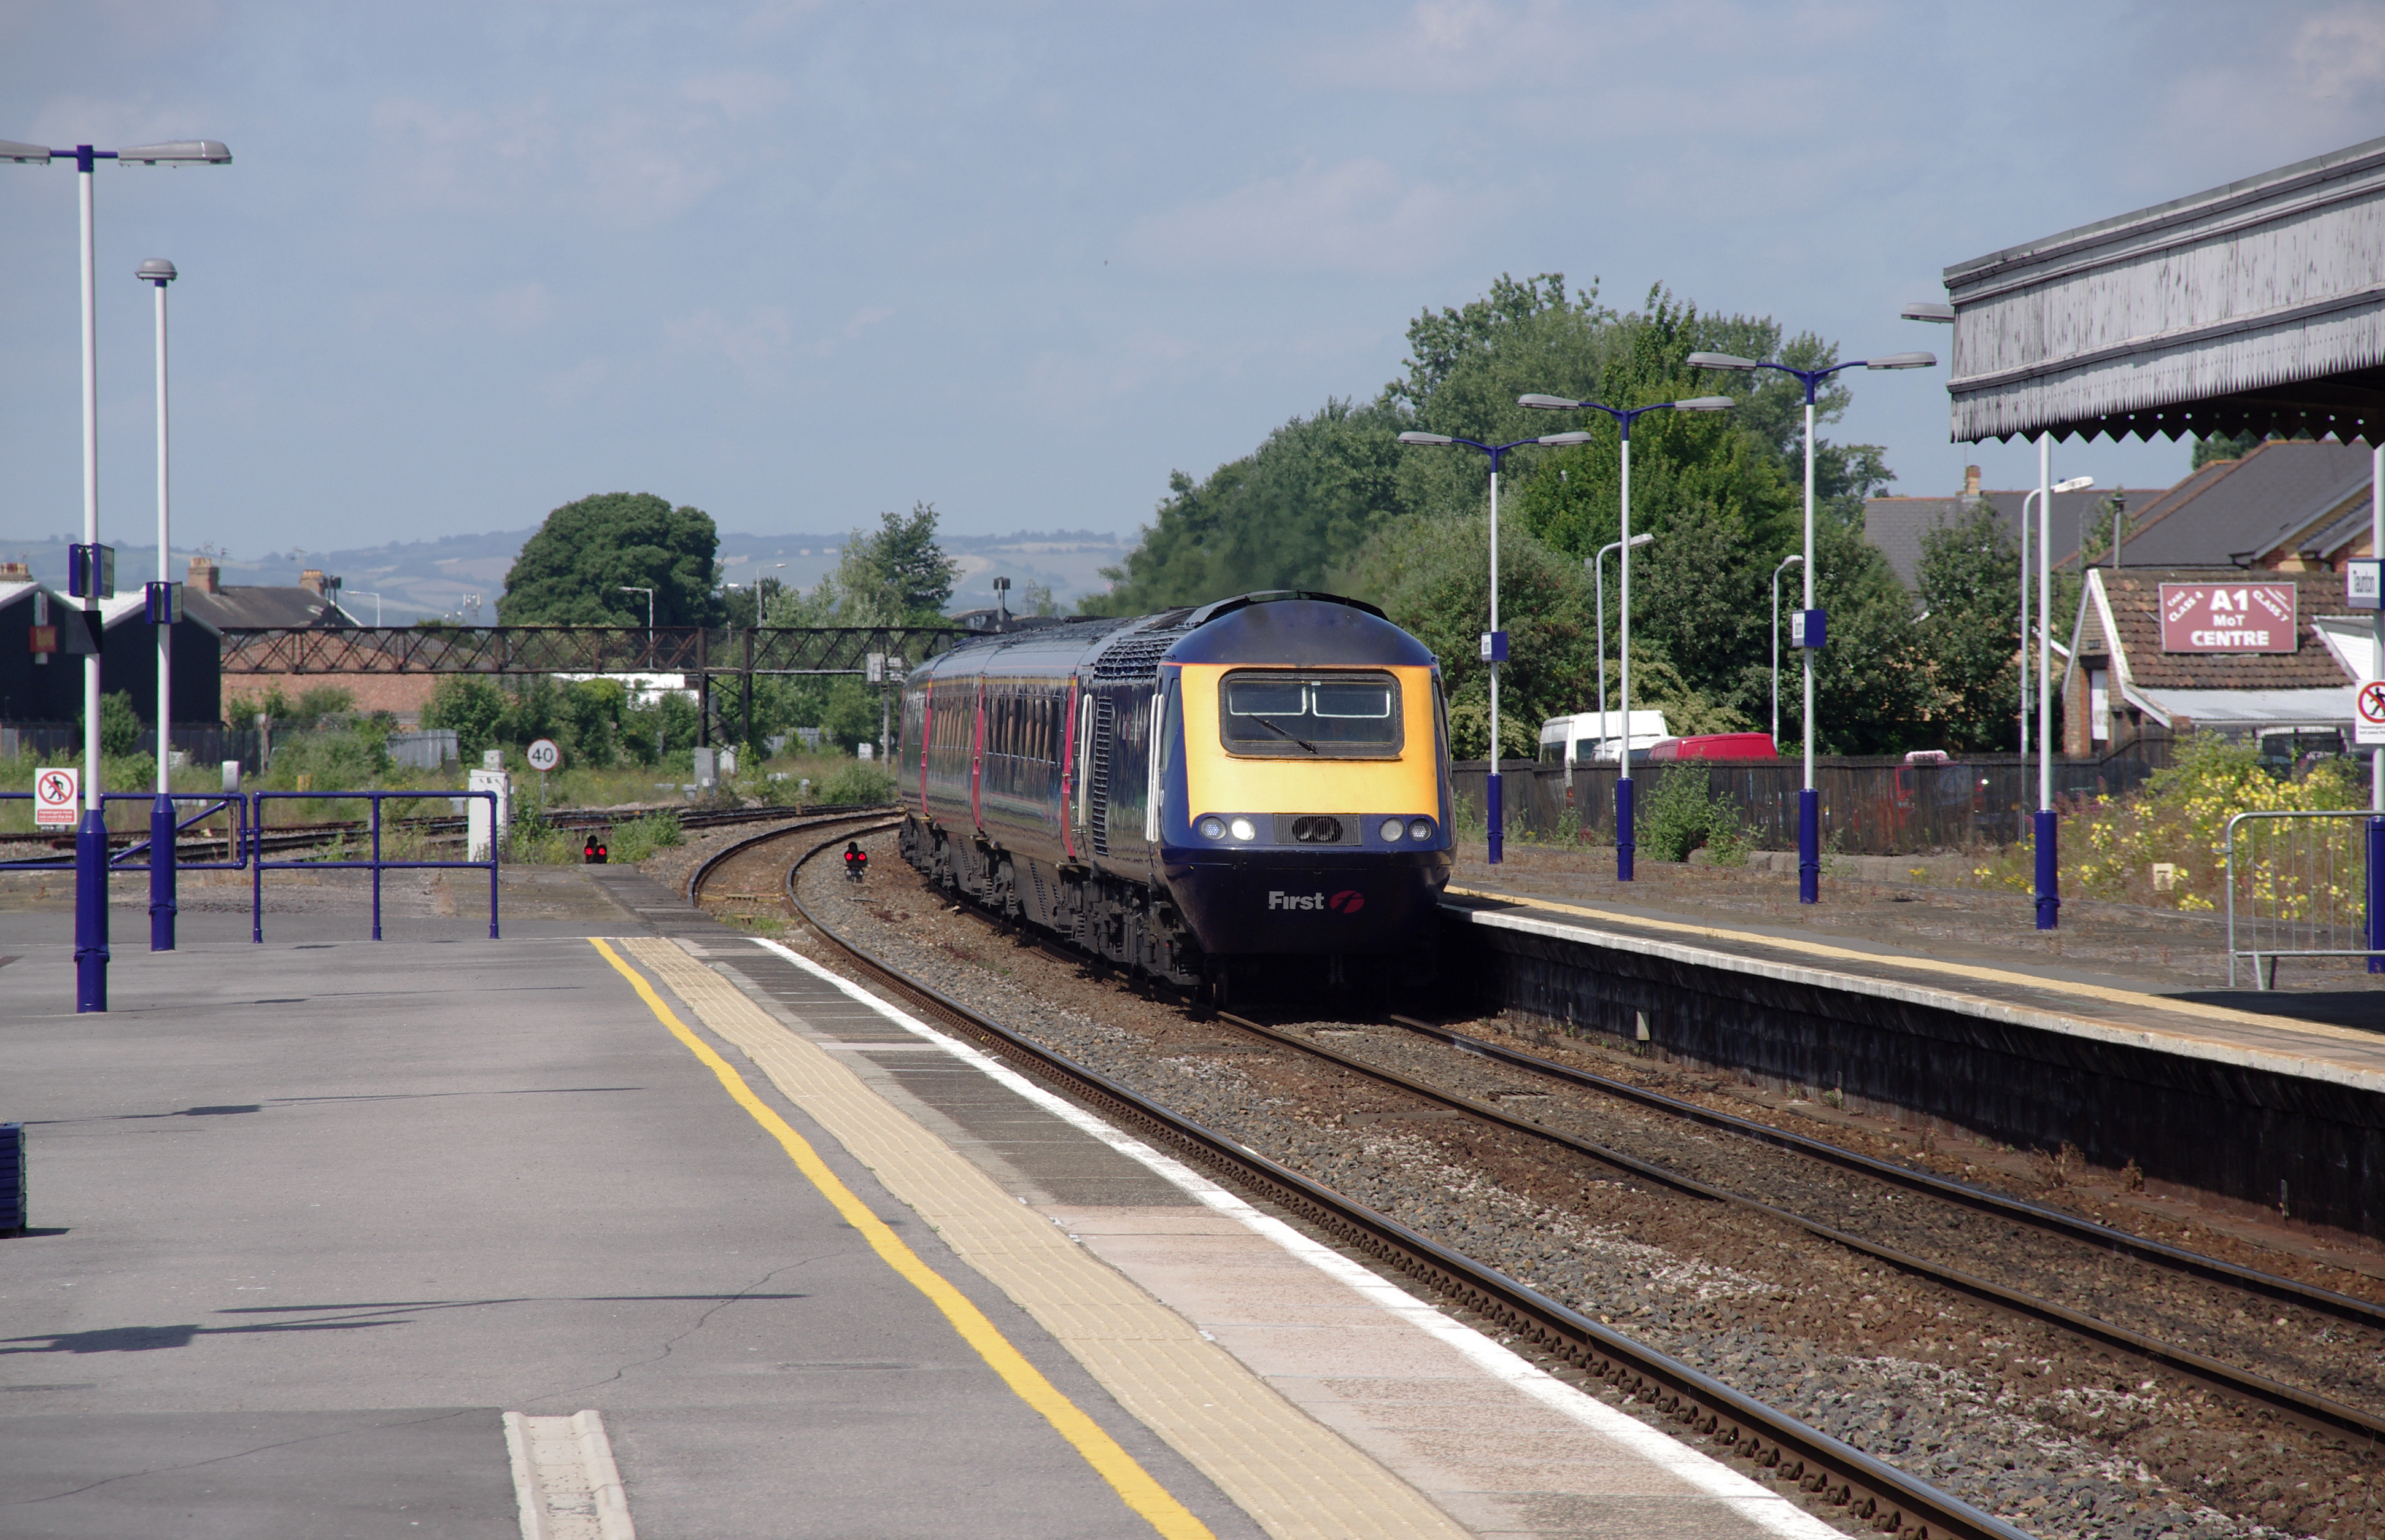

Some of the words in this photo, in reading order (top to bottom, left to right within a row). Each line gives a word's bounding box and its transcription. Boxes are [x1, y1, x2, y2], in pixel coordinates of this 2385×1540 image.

[2168, 596, 2197, 622] CLASS
[2195, 590, 2204, 599] 4
[2209, 589, 2249, 611] A1
[2252, 589, 2283, 617] CLASS
[2190, 630, 2270, 646] CENTRE
[532, 748, 554, 763] 40
[1269, 891, 1324, 910] First
